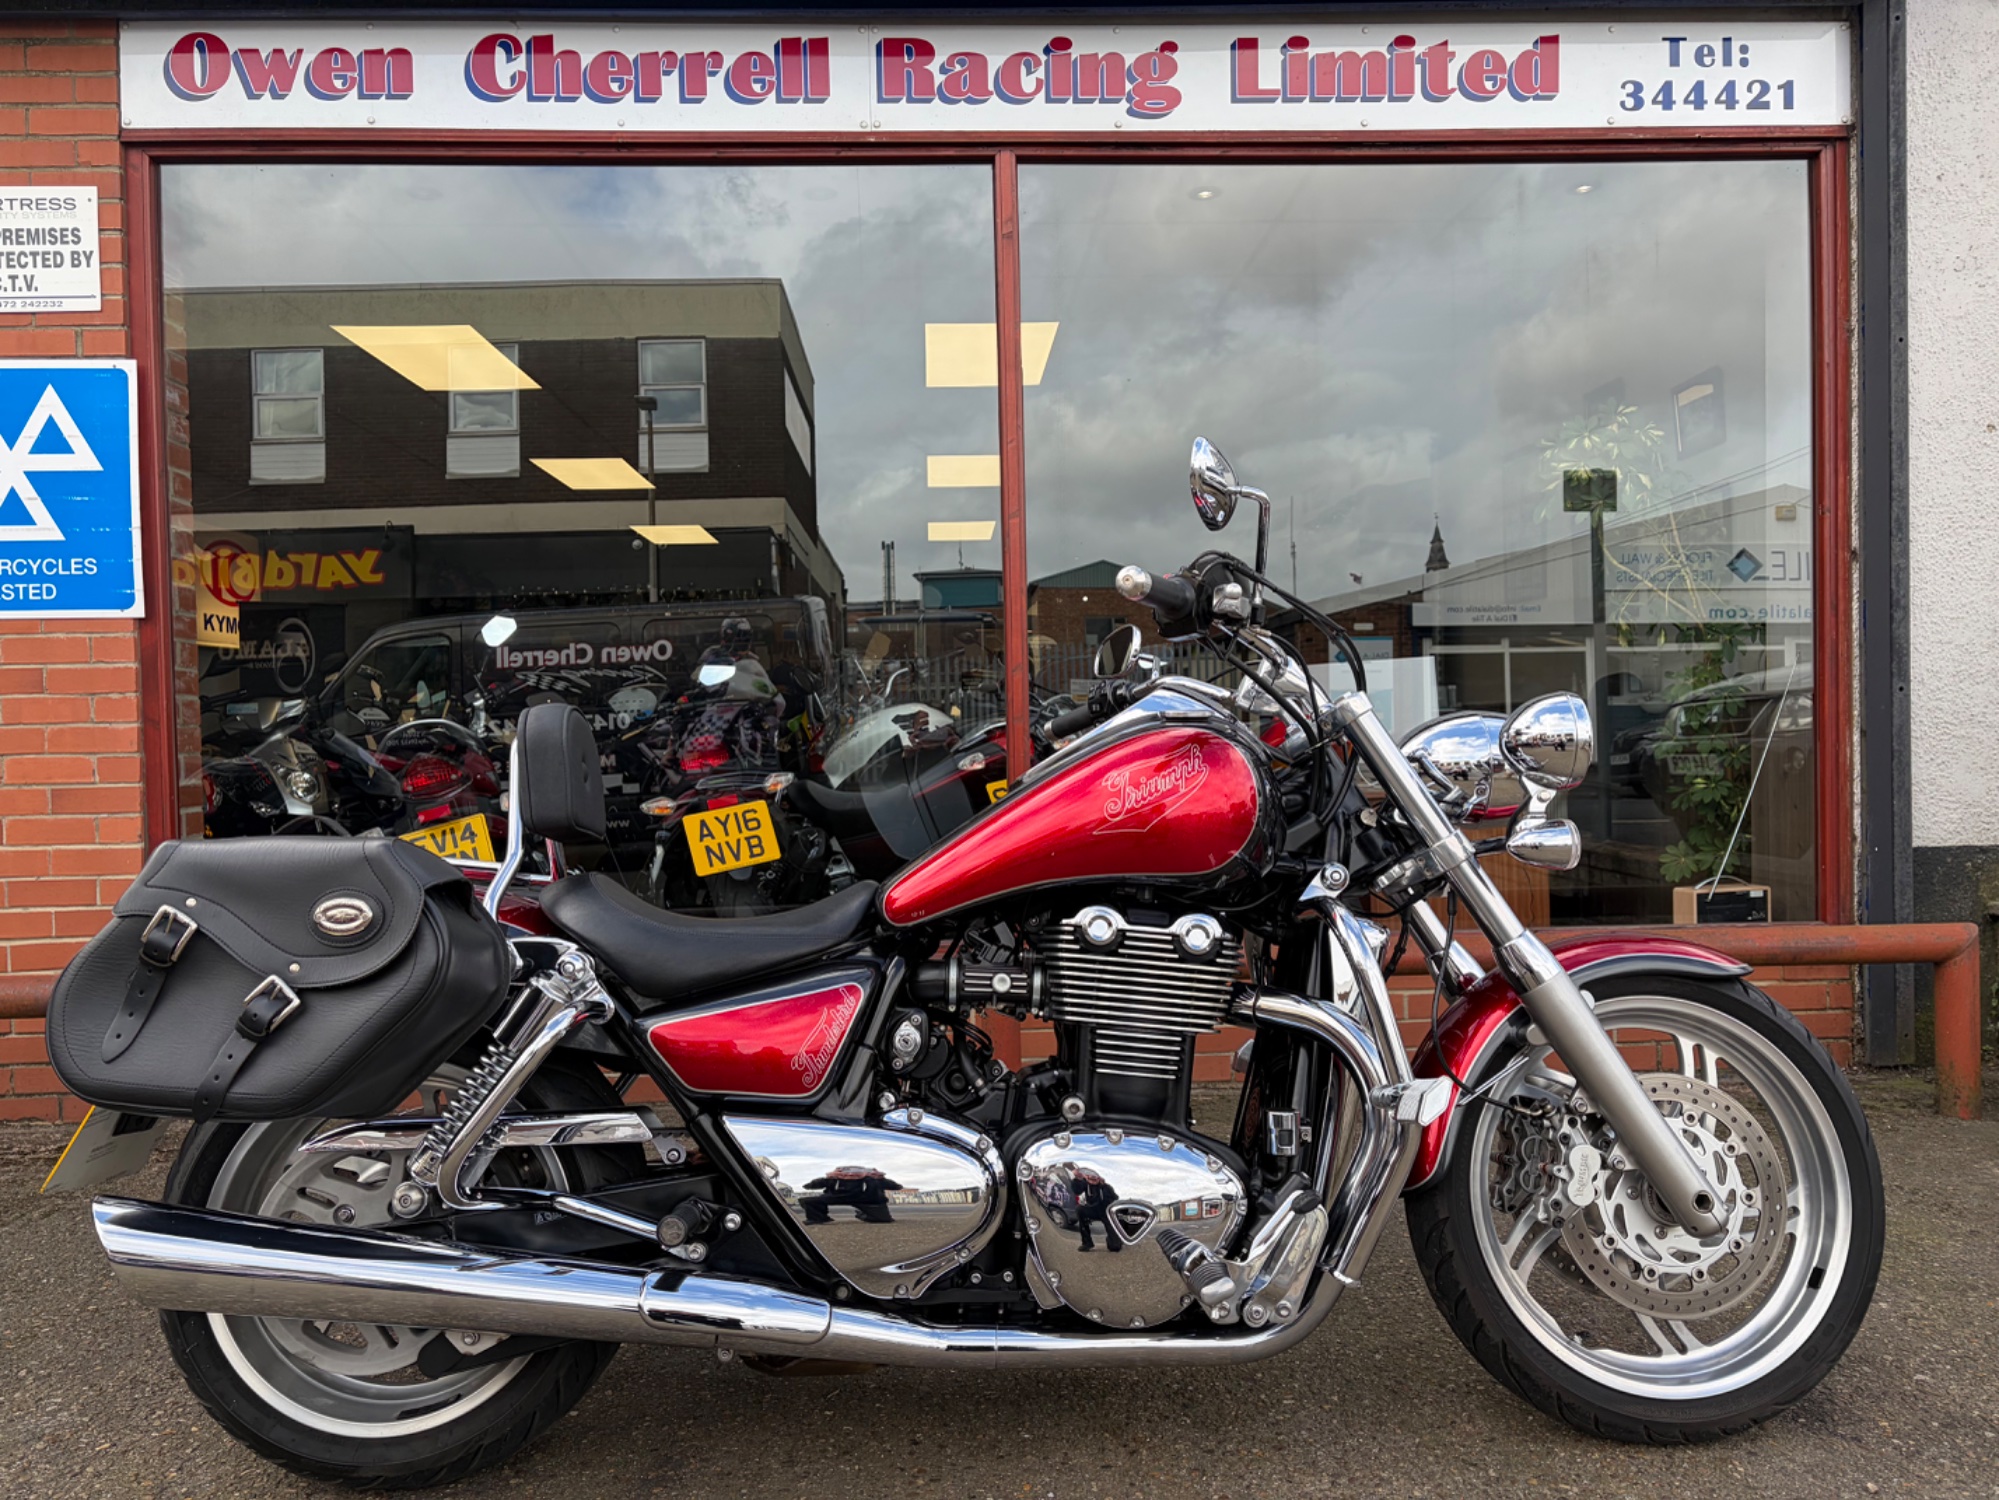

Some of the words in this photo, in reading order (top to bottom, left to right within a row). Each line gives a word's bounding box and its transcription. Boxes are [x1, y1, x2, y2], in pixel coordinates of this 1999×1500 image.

[1661, 36, 1750, 68] Tel:
[164, 30, 414, 103] Owen
[465, 32, 830, 105] Cherrell
[876, 36, 1182, 119] Racing
[1229, 34, 1560, 103] Limited
[1619, 79, 1795, 112] 344421
[0, 197, 77, 211] TRESS
[22, 211, 77, 220] SYSTEMS
[0, 226, 82, 246] REMISES
[70, 250, 94, 268] BY
[0, 273, 39, 292] .T.V.
[20, 300, 64, 308] 242232
[0, 583, 57, 600] STED
[203, 612, 240, 635] KYM
[1102, 744, 1208, 822] Triumph
[698, 808, 763, 843] AY16
[703, 834, 767, 868] NVB
